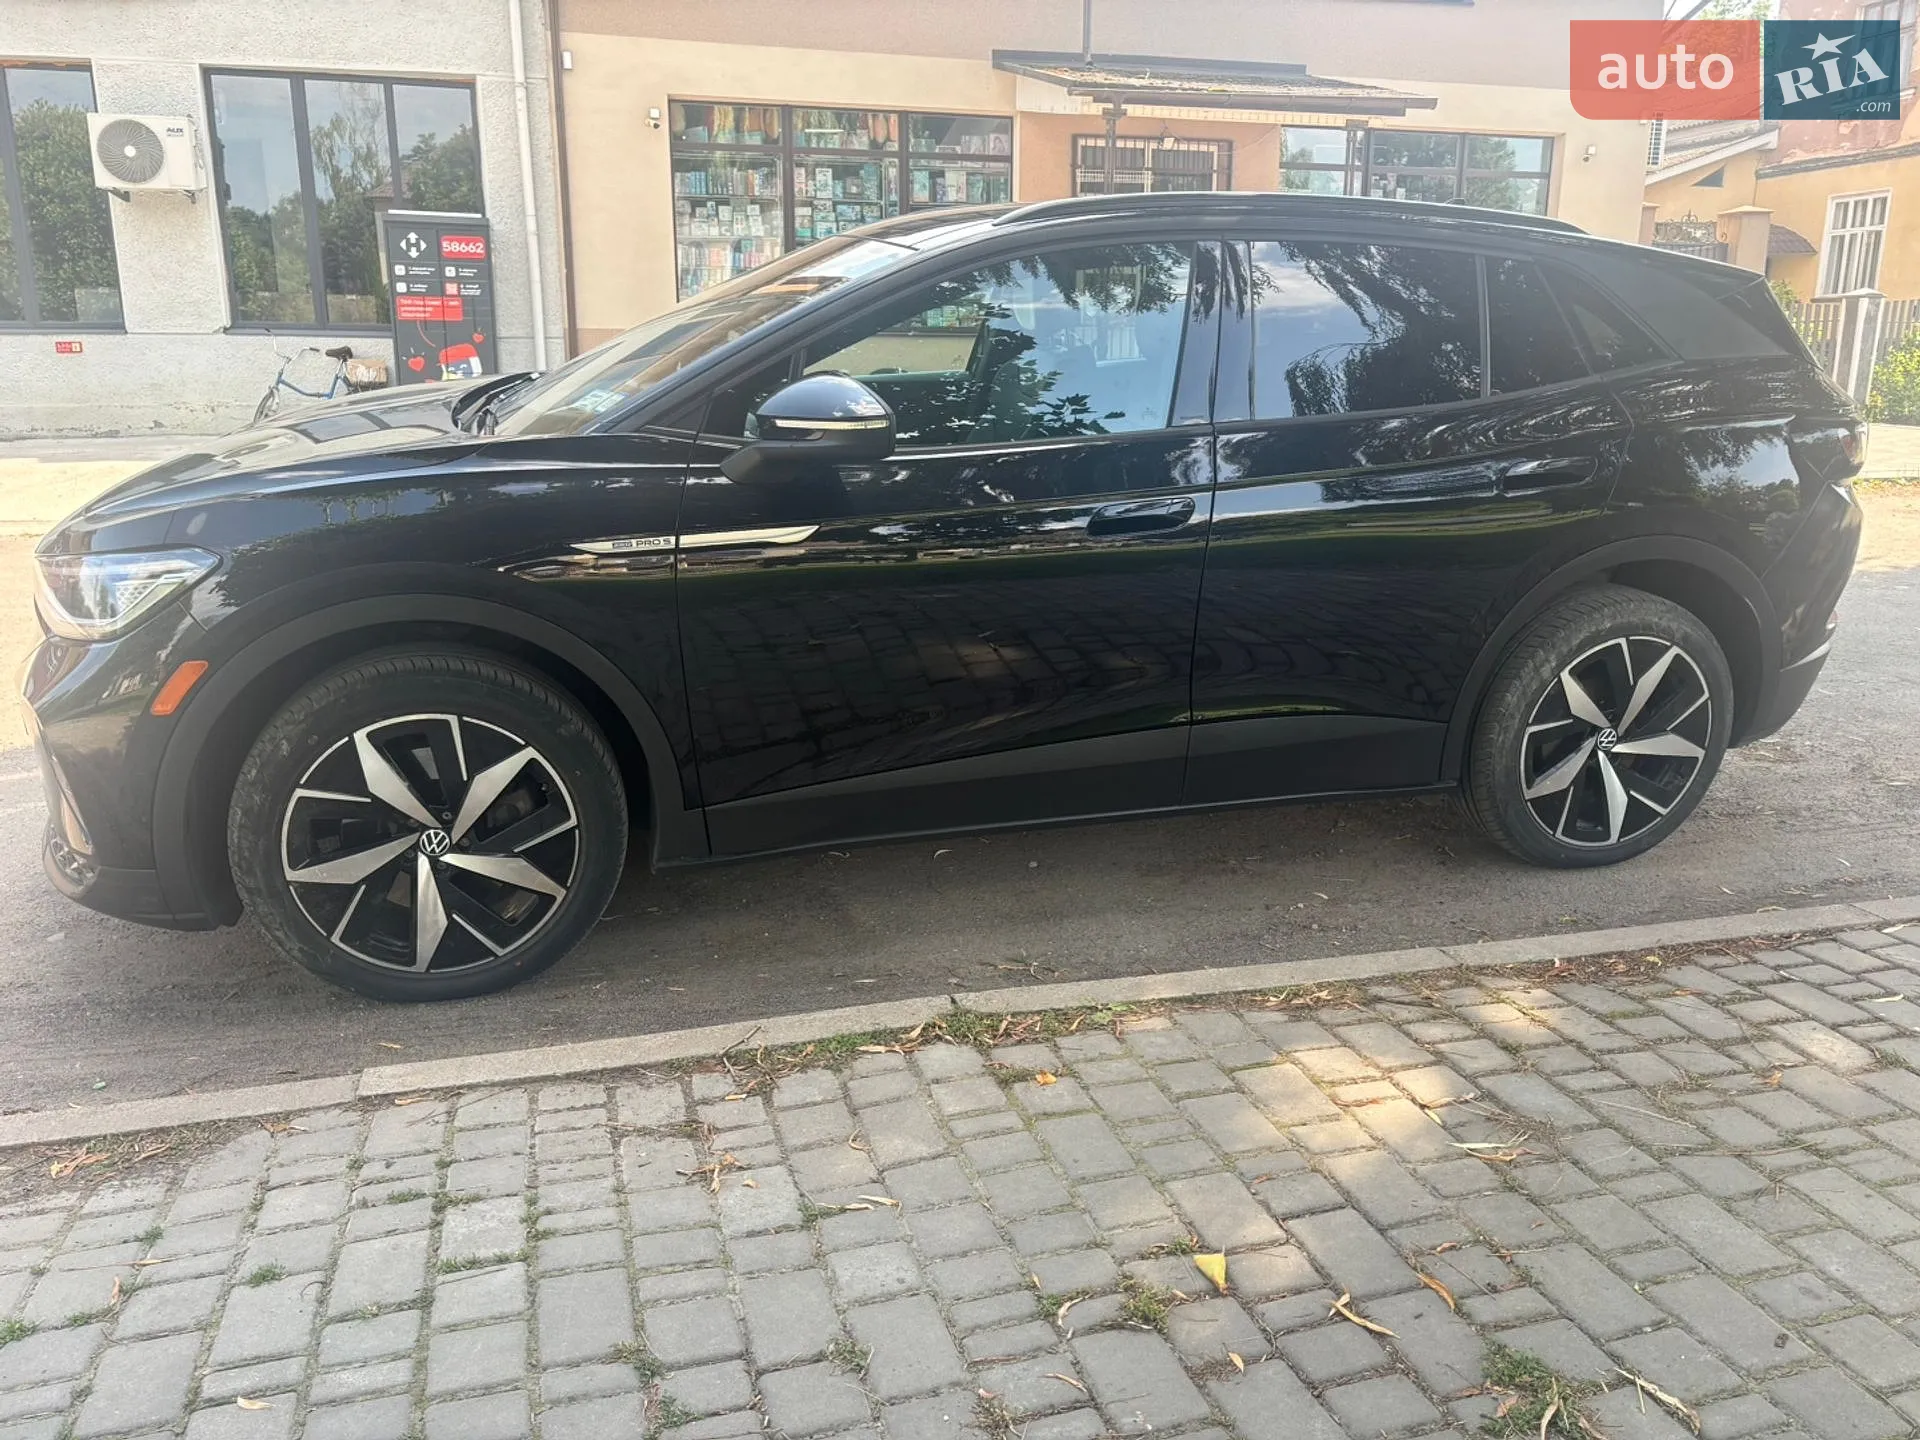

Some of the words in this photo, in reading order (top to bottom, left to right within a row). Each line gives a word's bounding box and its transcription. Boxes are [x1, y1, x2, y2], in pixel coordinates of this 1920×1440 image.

[442, 240, 485, 254] 58662
[636, 538, 661, 547] PRO
[663, 537, 672, 546] S
